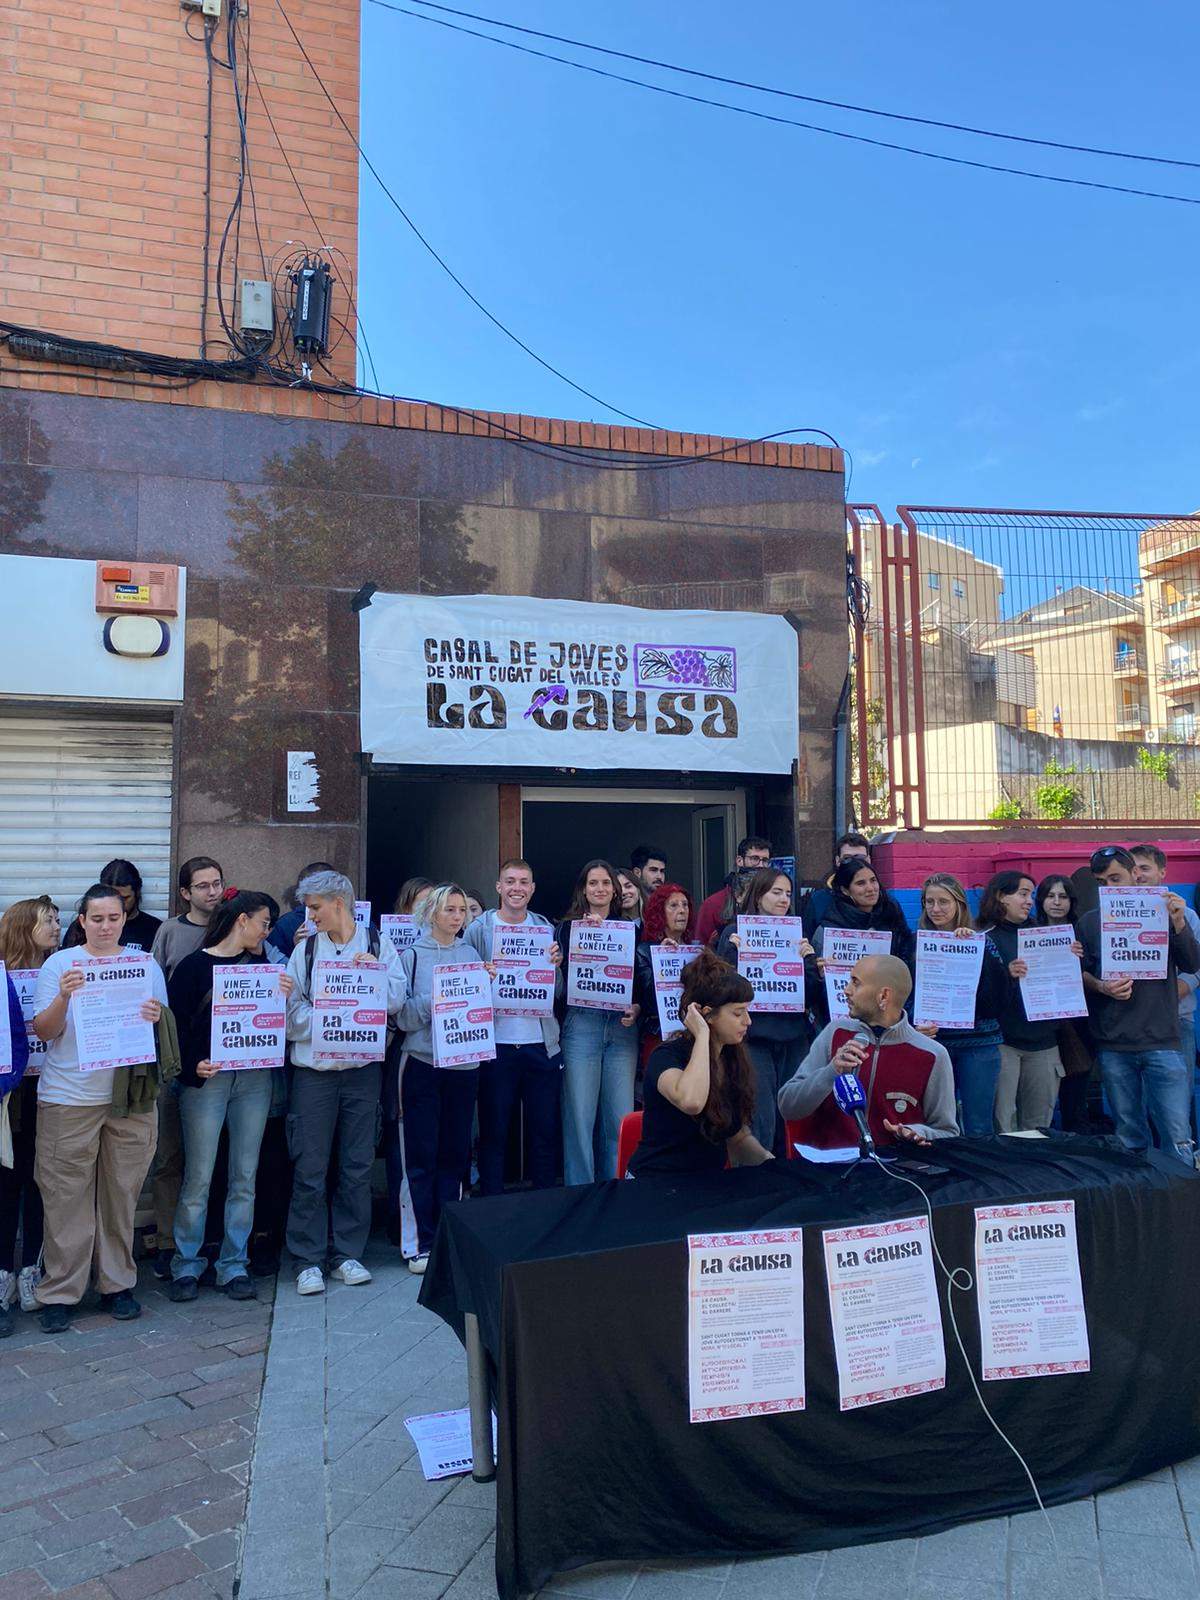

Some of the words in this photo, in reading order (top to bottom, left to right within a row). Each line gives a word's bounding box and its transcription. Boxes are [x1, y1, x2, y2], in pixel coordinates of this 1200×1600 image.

[424, 638, 499, 663] CASAL
[510, 640, 537, 665] DE
[549, 642, 629, 672] JOVES
[427, 665, 444, 678] DE
[449, 665, 483, 681] SANT
[489, 666, 533, 683] CUGAT
[539, 667, 565, 684] DEL
[1110, 900, 1135, 908] VINE
[1140, 900, 1145, 908] A
[390, 928, 413, 936] VINE
[746, 929, 771, 938] VINE
[775, 930, 780, 938] A
[579, 933, 603, 941] VINE
[502, 938, 526, 946] VINE
[833, 942, 858, 951] VINE
[325, 975, 353, 983] VINE
[357, 975, 363, 983] A
[441, 978, 460, 987] VINE
[464, 977, 468, 985] A
[224, 980, 251, 989] VINE
[255, 979, 261, 988] A
